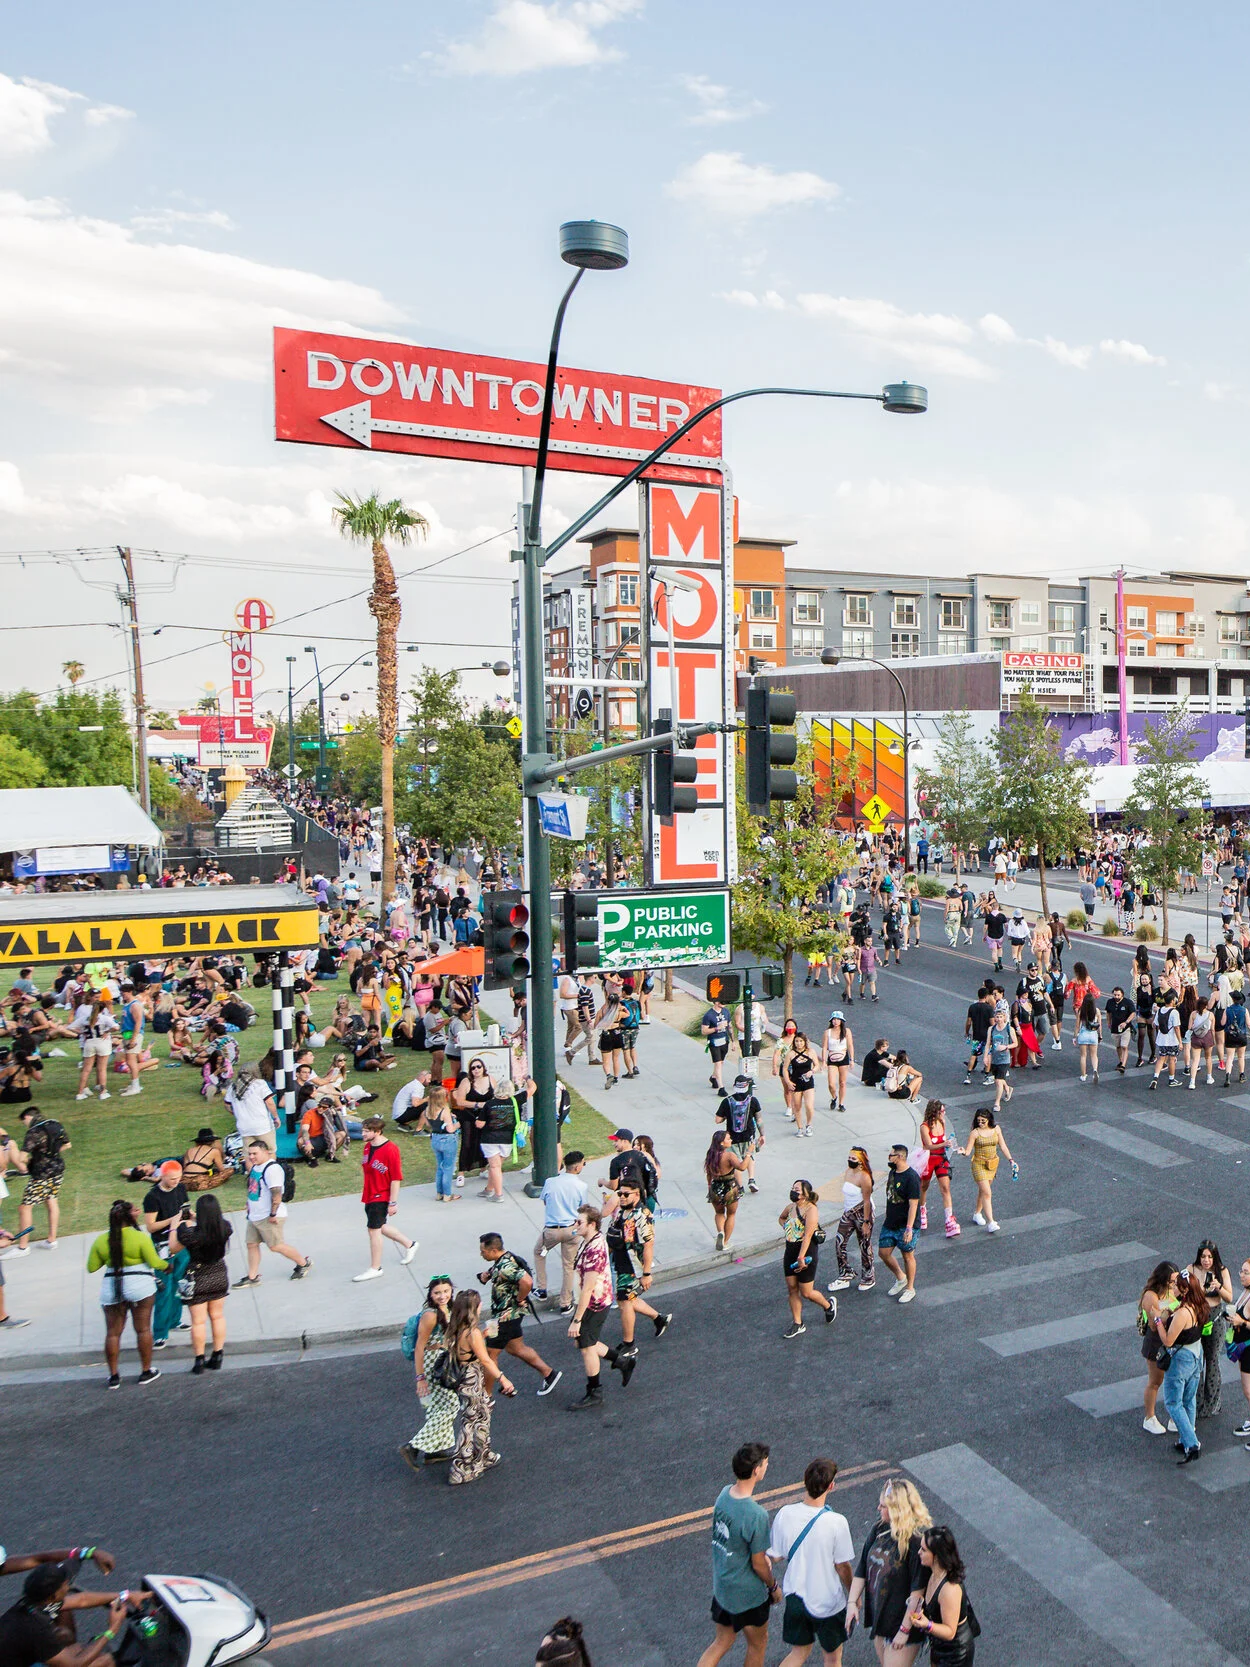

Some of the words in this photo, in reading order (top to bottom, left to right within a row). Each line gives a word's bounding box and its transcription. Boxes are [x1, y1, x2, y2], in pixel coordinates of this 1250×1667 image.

[307, 350, 691, 433] DOWNTOWNER
[577, 594, 589, 680] FREMONT
[1008, 654, 1079, 667] CASINO
[232, 634, 253, 739] MOTEL
[579, 698, 590, 712] 9
[162, 917, 281, 947] SHACK
[598, 903, 631, 949] P
[634, 905, 698, 922] PUBLIC
[634, 922, 713, 939] PARKING
